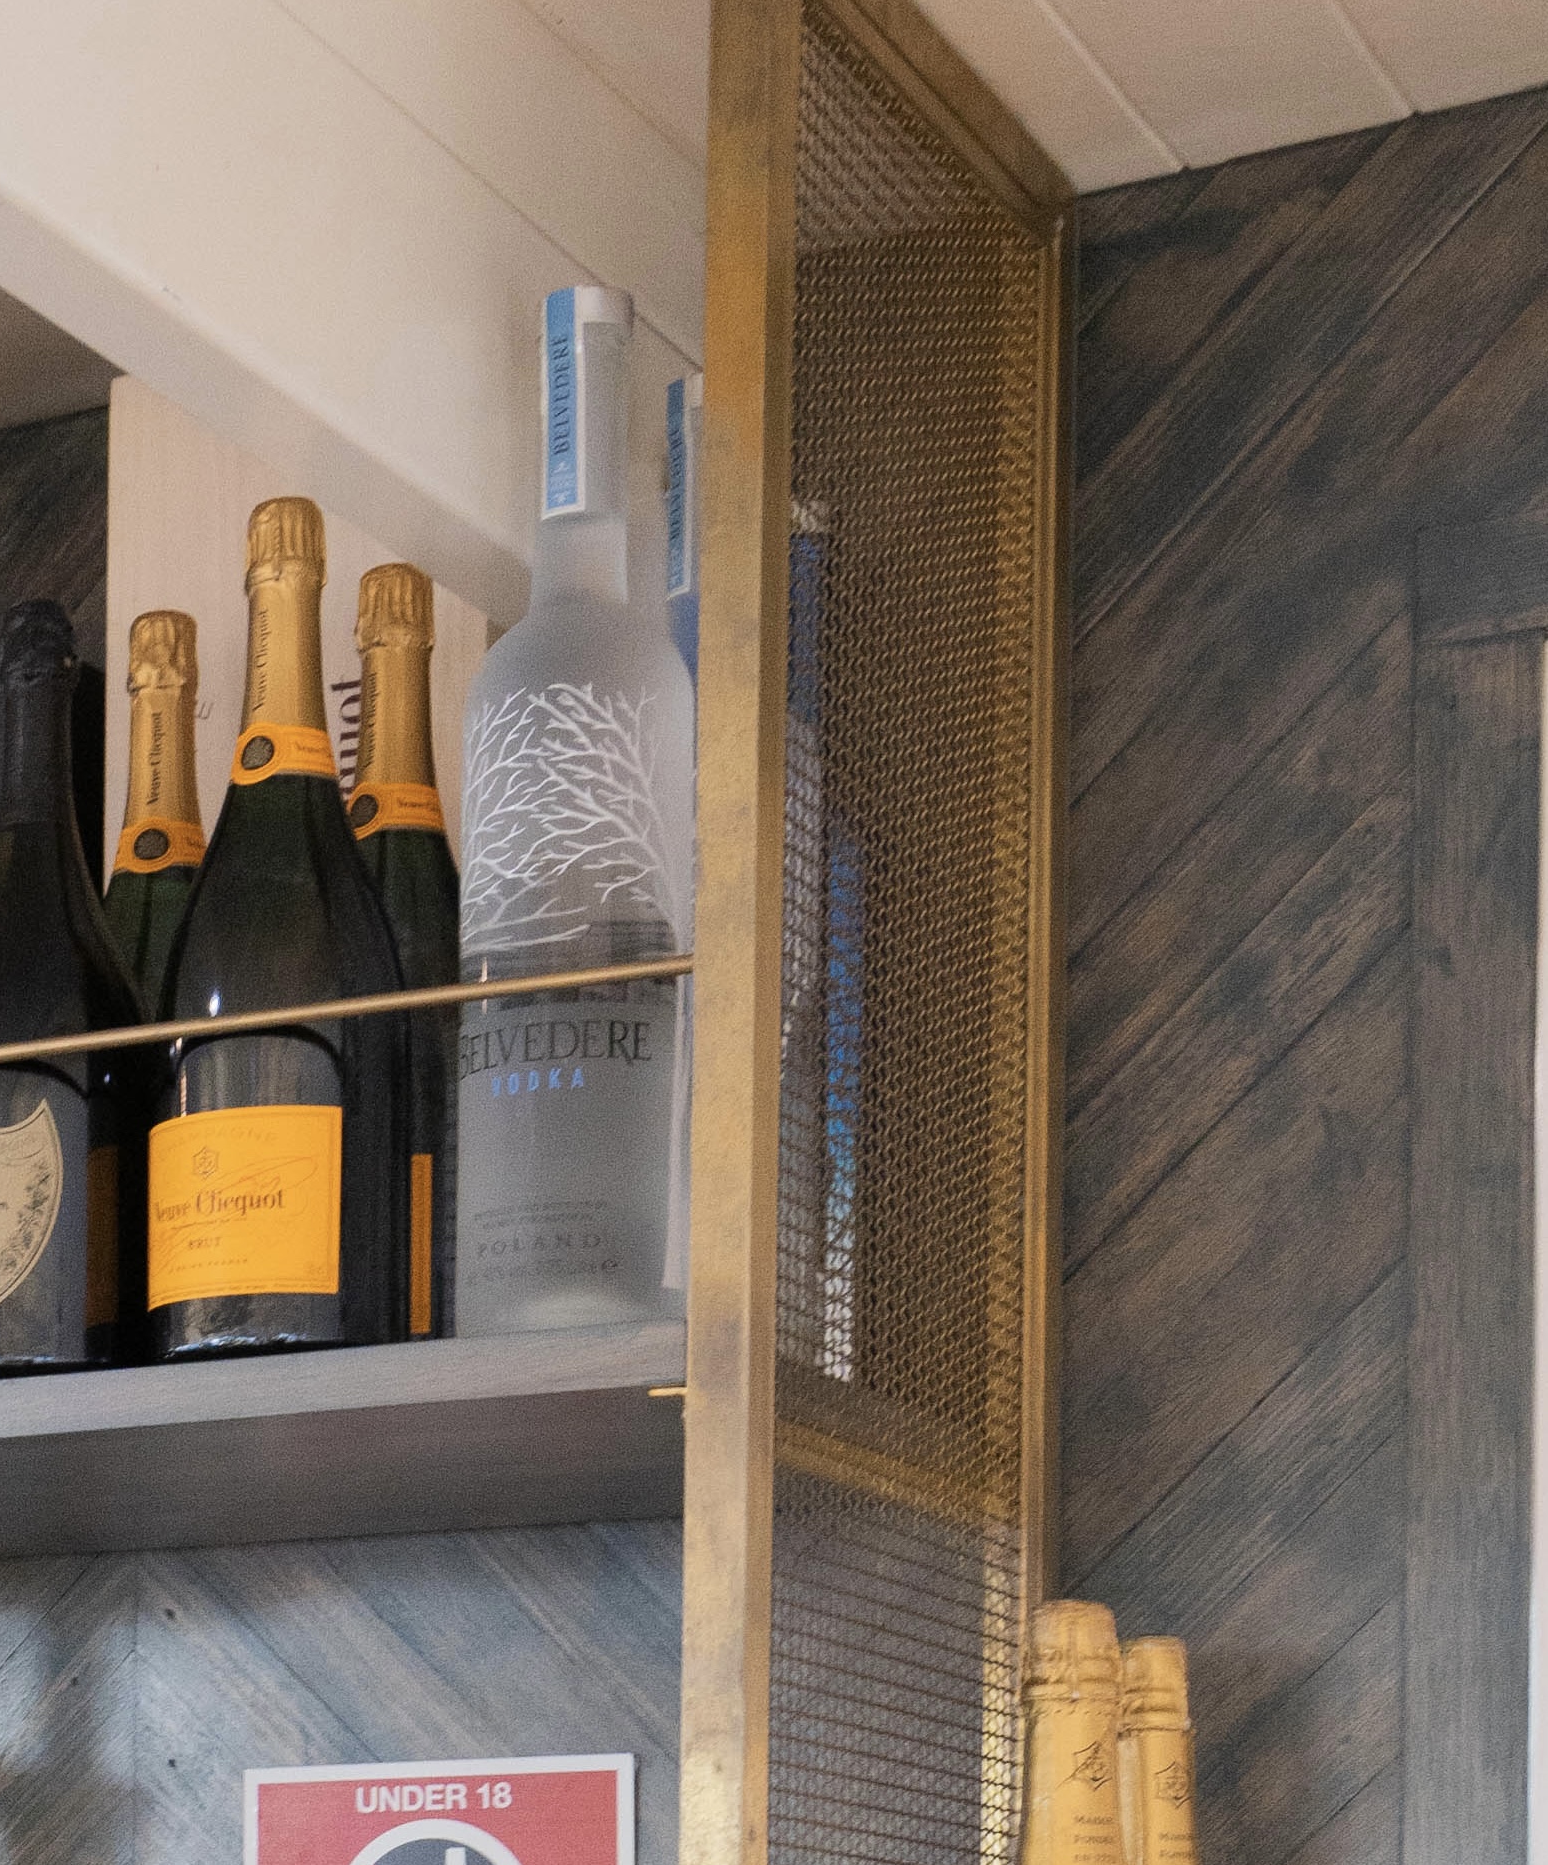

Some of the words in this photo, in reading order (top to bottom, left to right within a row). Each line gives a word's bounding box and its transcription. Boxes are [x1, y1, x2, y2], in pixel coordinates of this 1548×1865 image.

[491, 1067, 585, 1098] VODKA
[195, 1188, 286, 1217] Clicquot
[355, 1783, 468, 1814] UNDER
[476, 1781, 513, 1809] 18
